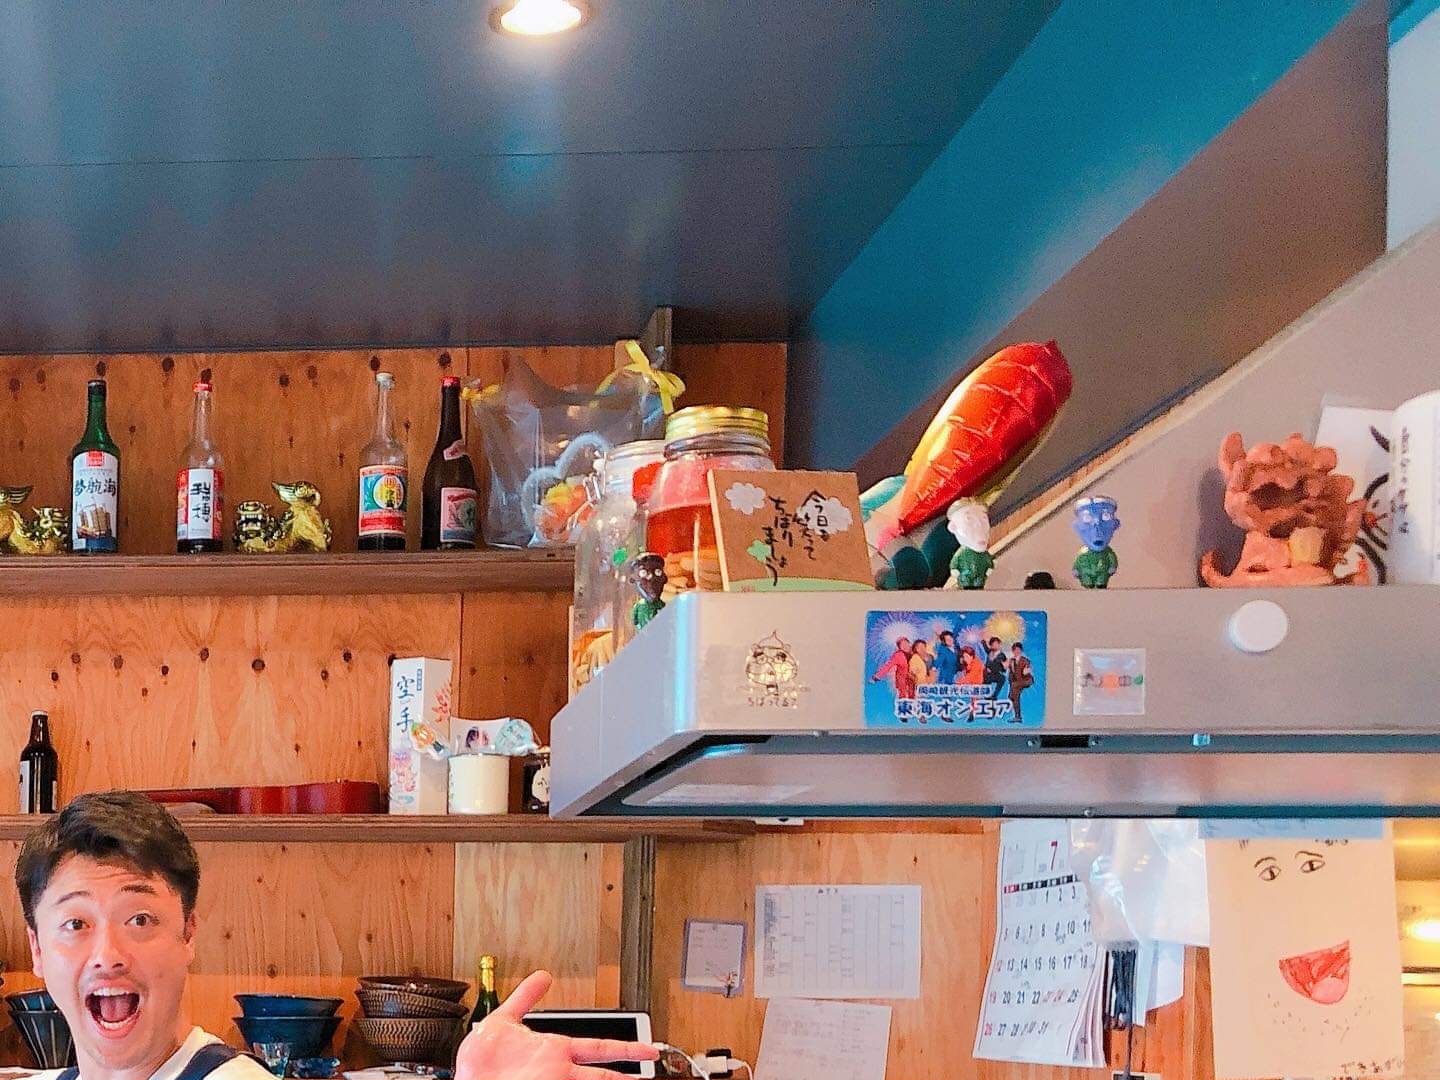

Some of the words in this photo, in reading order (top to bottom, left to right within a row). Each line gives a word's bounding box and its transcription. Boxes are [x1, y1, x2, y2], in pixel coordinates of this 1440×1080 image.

[396, 676, 415, 734] 空手
[896, 699, 1016, 718] 東海オンエア
[1050, 841, 1058, 871] 7
[1067, 920, 1075, 934] 10
[1007, 958, 1014, 971] 13
[1020, 958, 1028, 971] 14
[1034, 956, 1042, 970] 15
[1048, 956, 1056, 970] 16
[1063, 954, 1072, 969] 17
[1080, 954, 1088, 968] 18
[1002, 990, 1011, 1004] 20
[1016, 990, 1025, 1004] 21
[1067, 988, 1079, 1003] 25
[997, 1023, 1007, 1036] 27
